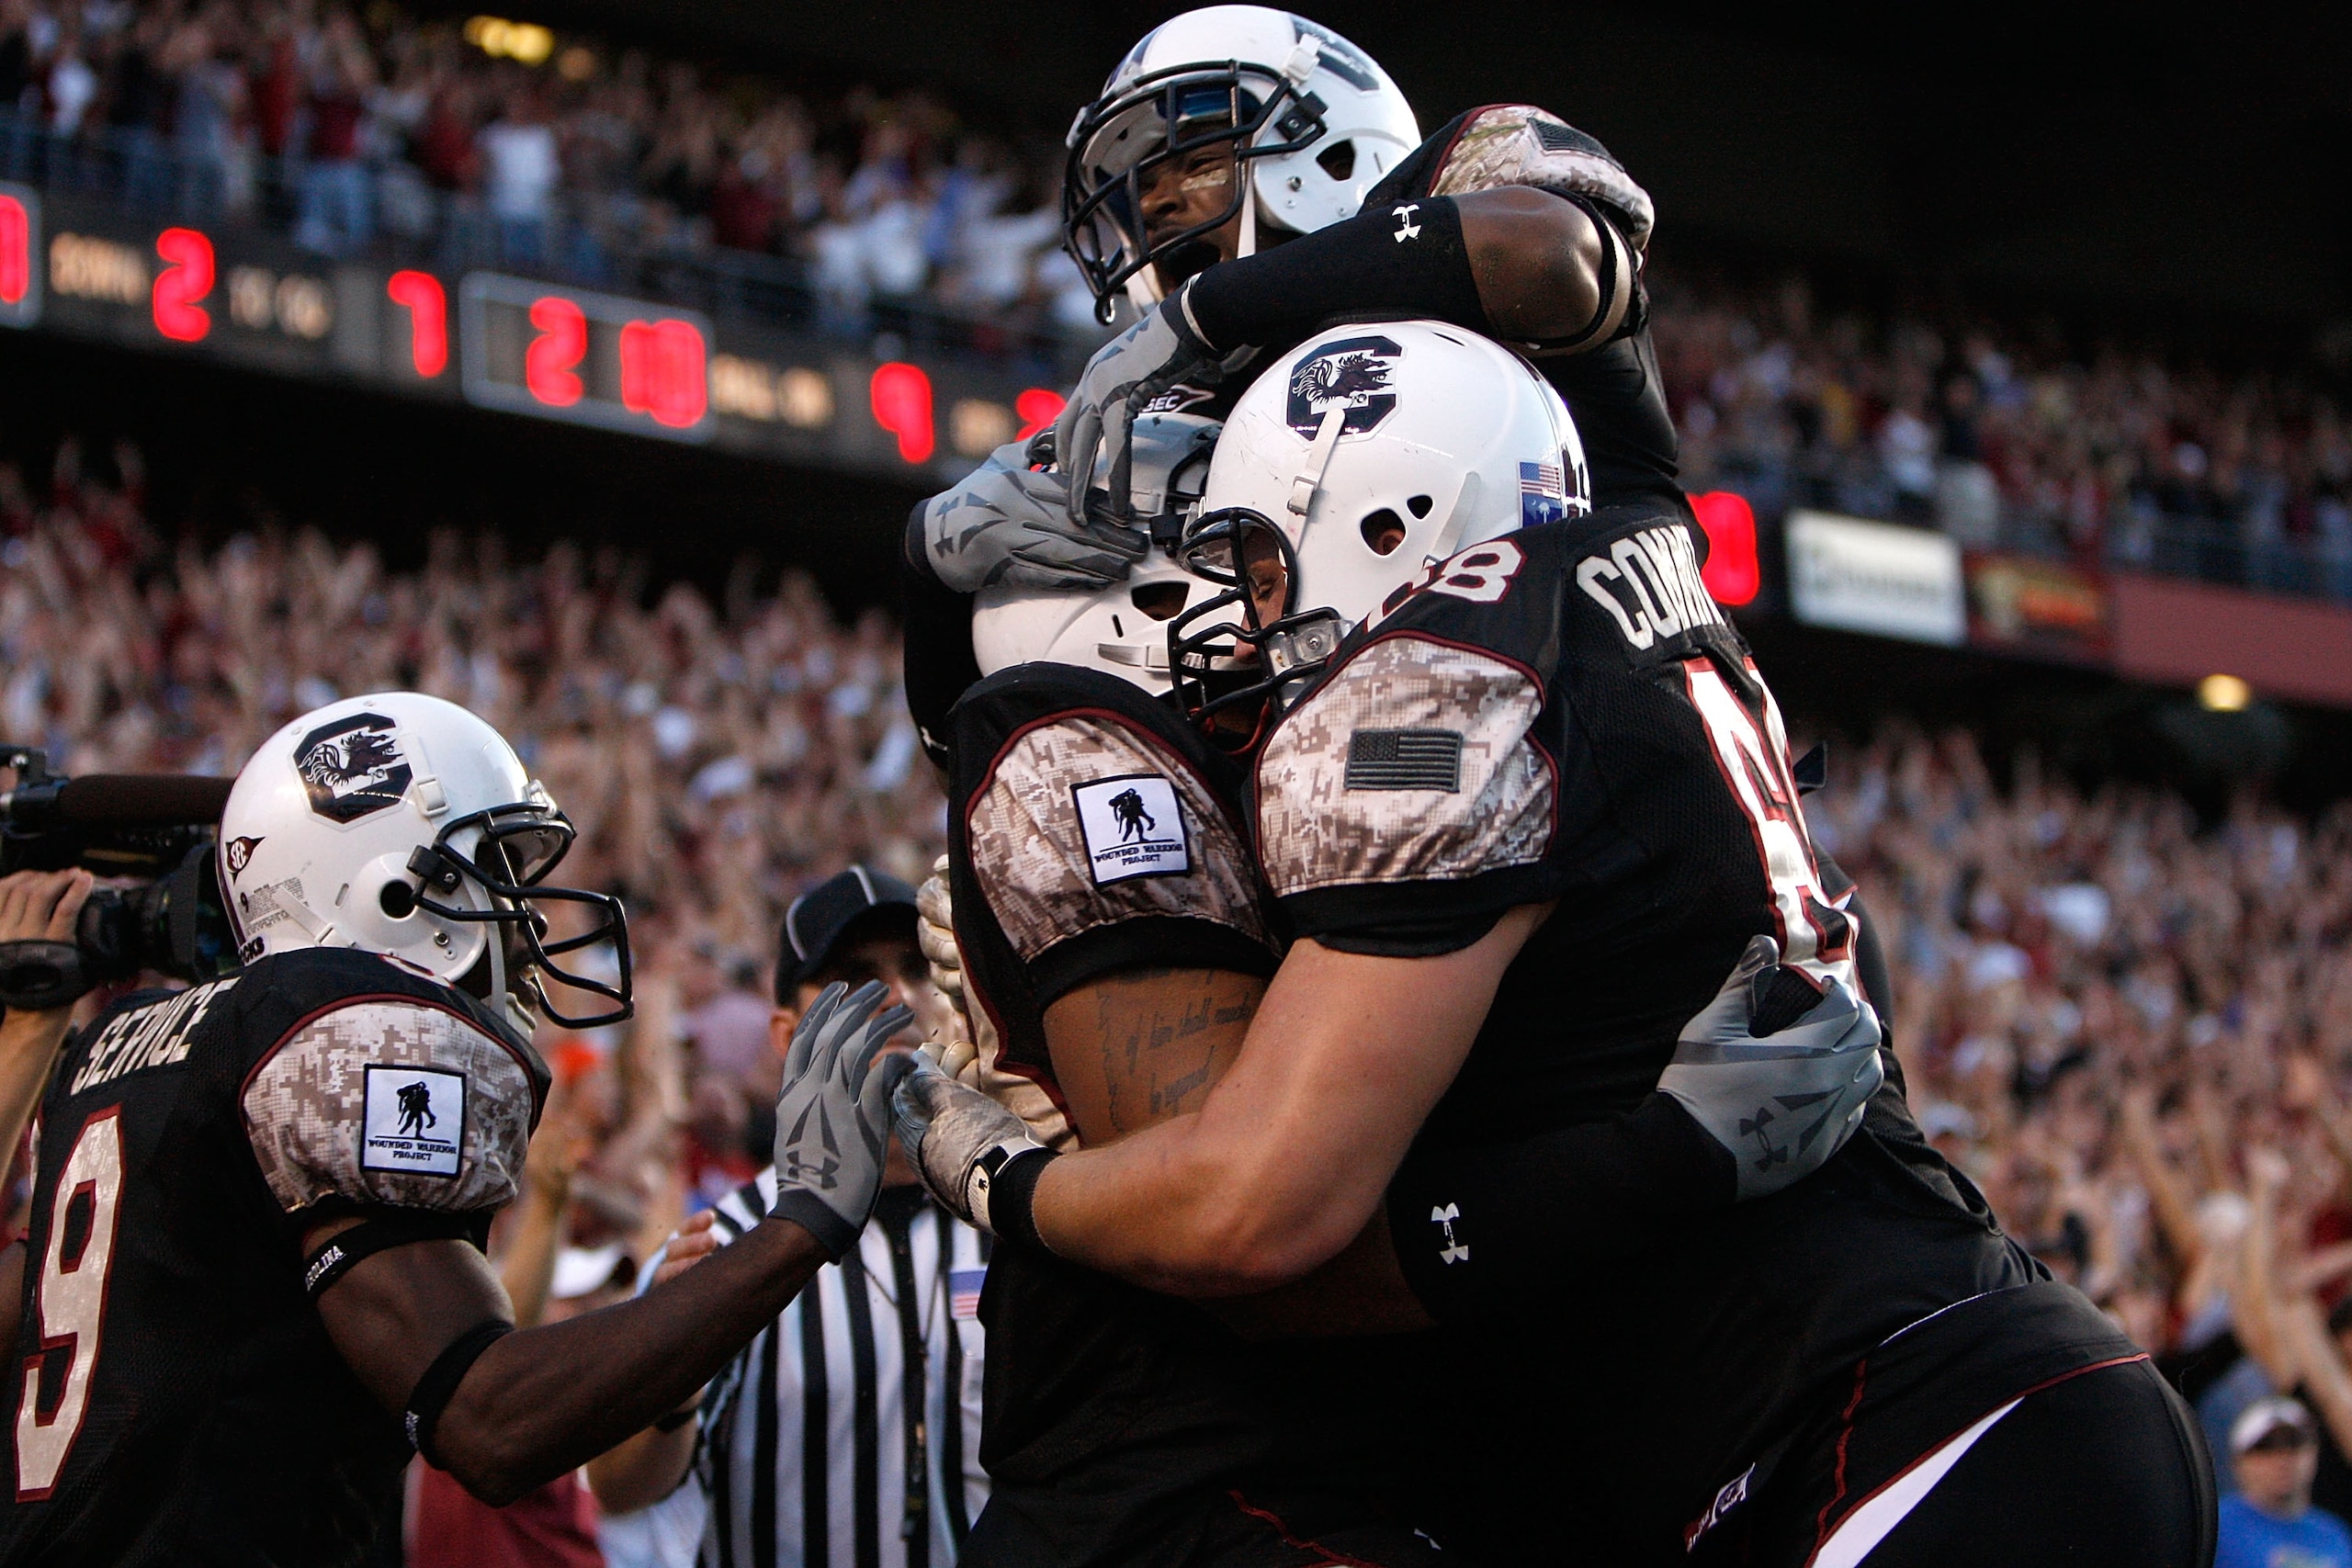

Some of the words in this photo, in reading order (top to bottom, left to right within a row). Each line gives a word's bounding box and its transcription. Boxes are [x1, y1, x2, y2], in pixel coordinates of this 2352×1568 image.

[153, 227, 215, 343] 2
[231, 840, 247, 869] SEC
[1094, 847, 1139, 863] WOUNDED
[1143, 843, 1184, 853] WARRIOR
[1122, 853, 1161, 865] PROJECT
[368, 1139, 413, 1150] WOUNDED
[416, 1143, 458, 1155] WARRIOR
[392, 1150, 433, 1161] PROJECT
[16, 1104, 126, 1503] 9
